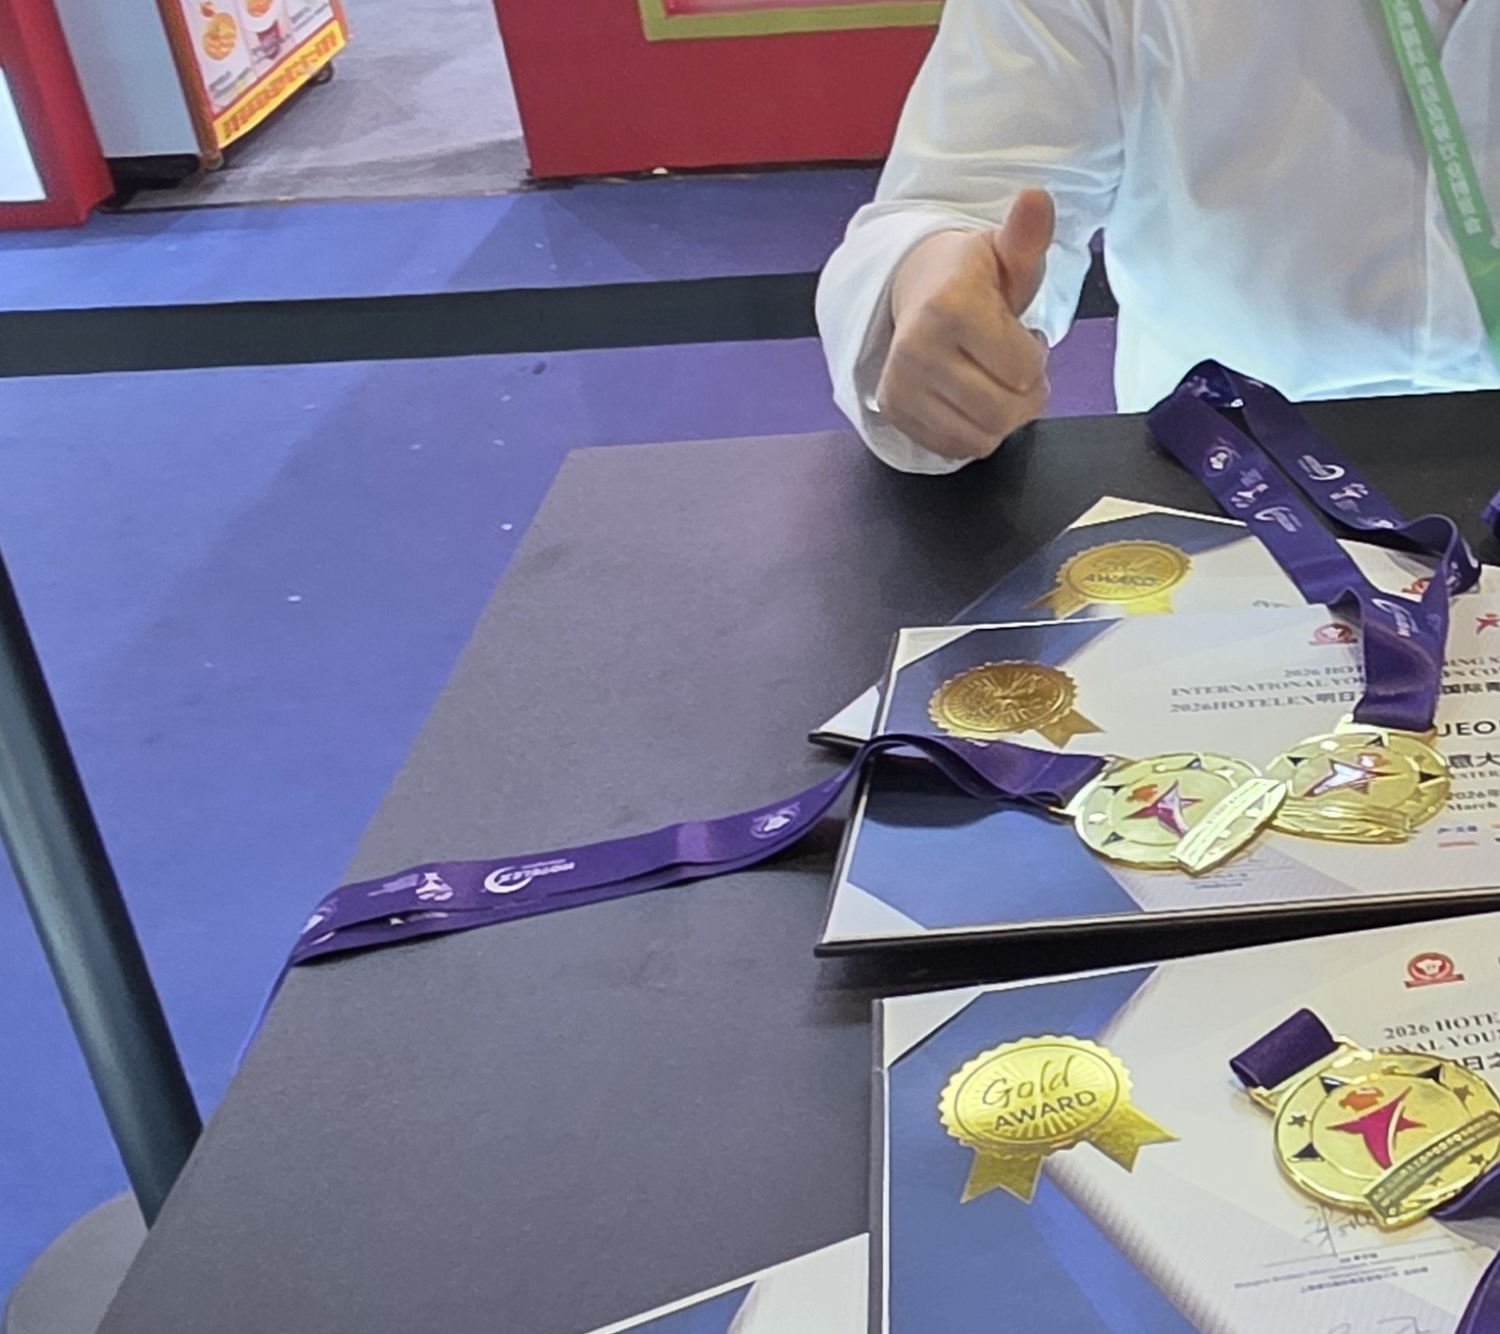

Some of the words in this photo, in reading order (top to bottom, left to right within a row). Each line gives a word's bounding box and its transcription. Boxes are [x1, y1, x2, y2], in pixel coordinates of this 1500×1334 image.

[1384, 1023, 1433, 1041] 2026
[980, 1053, 1076, 1108] Gold
[992, 1089, 1098, 1131] AWARD
